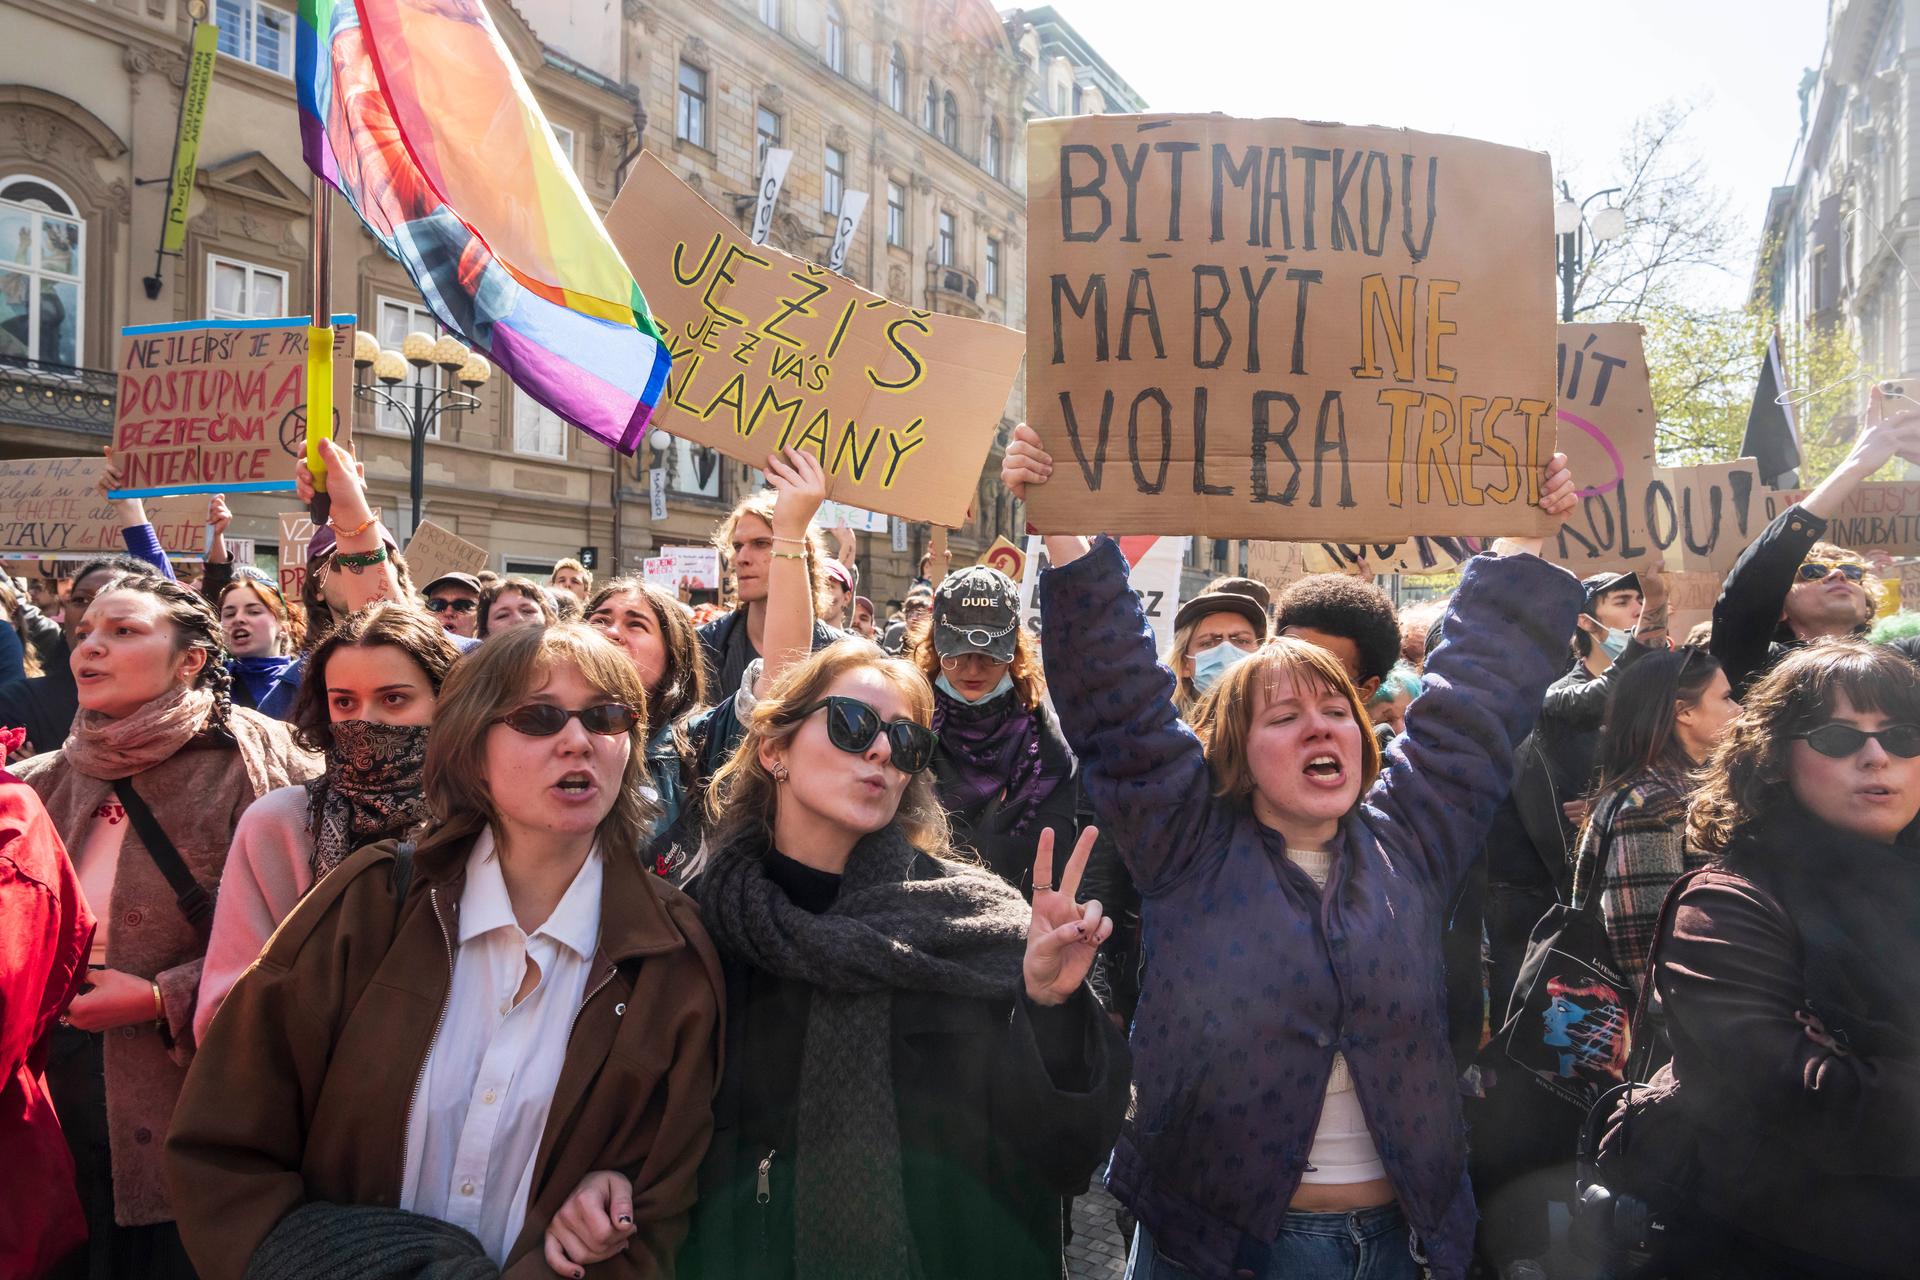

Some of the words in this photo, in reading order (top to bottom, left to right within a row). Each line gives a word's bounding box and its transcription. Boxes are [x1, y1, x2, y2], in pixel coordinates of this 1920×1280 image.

[183, 51, 204, 142] FOUNDATION
[196, 52, 213, 115] MUSEUM
[191, 119, 204, 144] ART
[1061, 119, 1200, 243] BÝT
[1208, 142, 1438, 264] MATKOU
[673, 233, 932, 390] JEŽÍŠ
[1050, 252, 1171, 365] MÁ
[1192, 254, 1323, 376] BÝT
[1350, 273, 1460, 383] NE
[127, 330, 244, 370] NEJLEPŠÍ
[248, 332, 271, 358] JE
[686, 316, 728, 349] JE
[732, 331, 762, 365] Z
[771, 346, 830, 391] VÁS
[1558, 332, 1627, 407] ÍT
[119, 360, 275, 420] DOSTUPNÁ
[270, 363, 303, 409] A
[654, 319, 924, 489] KLAMANÝ
[119, 410, 280, 451] BEZPEČNÁ
[1058, 386, 1358, 509] VOLBA
[1377, 388, 1552, 507] TREST
[121, 446, 273, 489] INTERUPCE
[653, 472, 662, 517] MANGO
[1841, 486, 1920, 514] NEJSM
[0, 522, 76, 550] TAVY
[961, 597, 999, 608] DUDE
